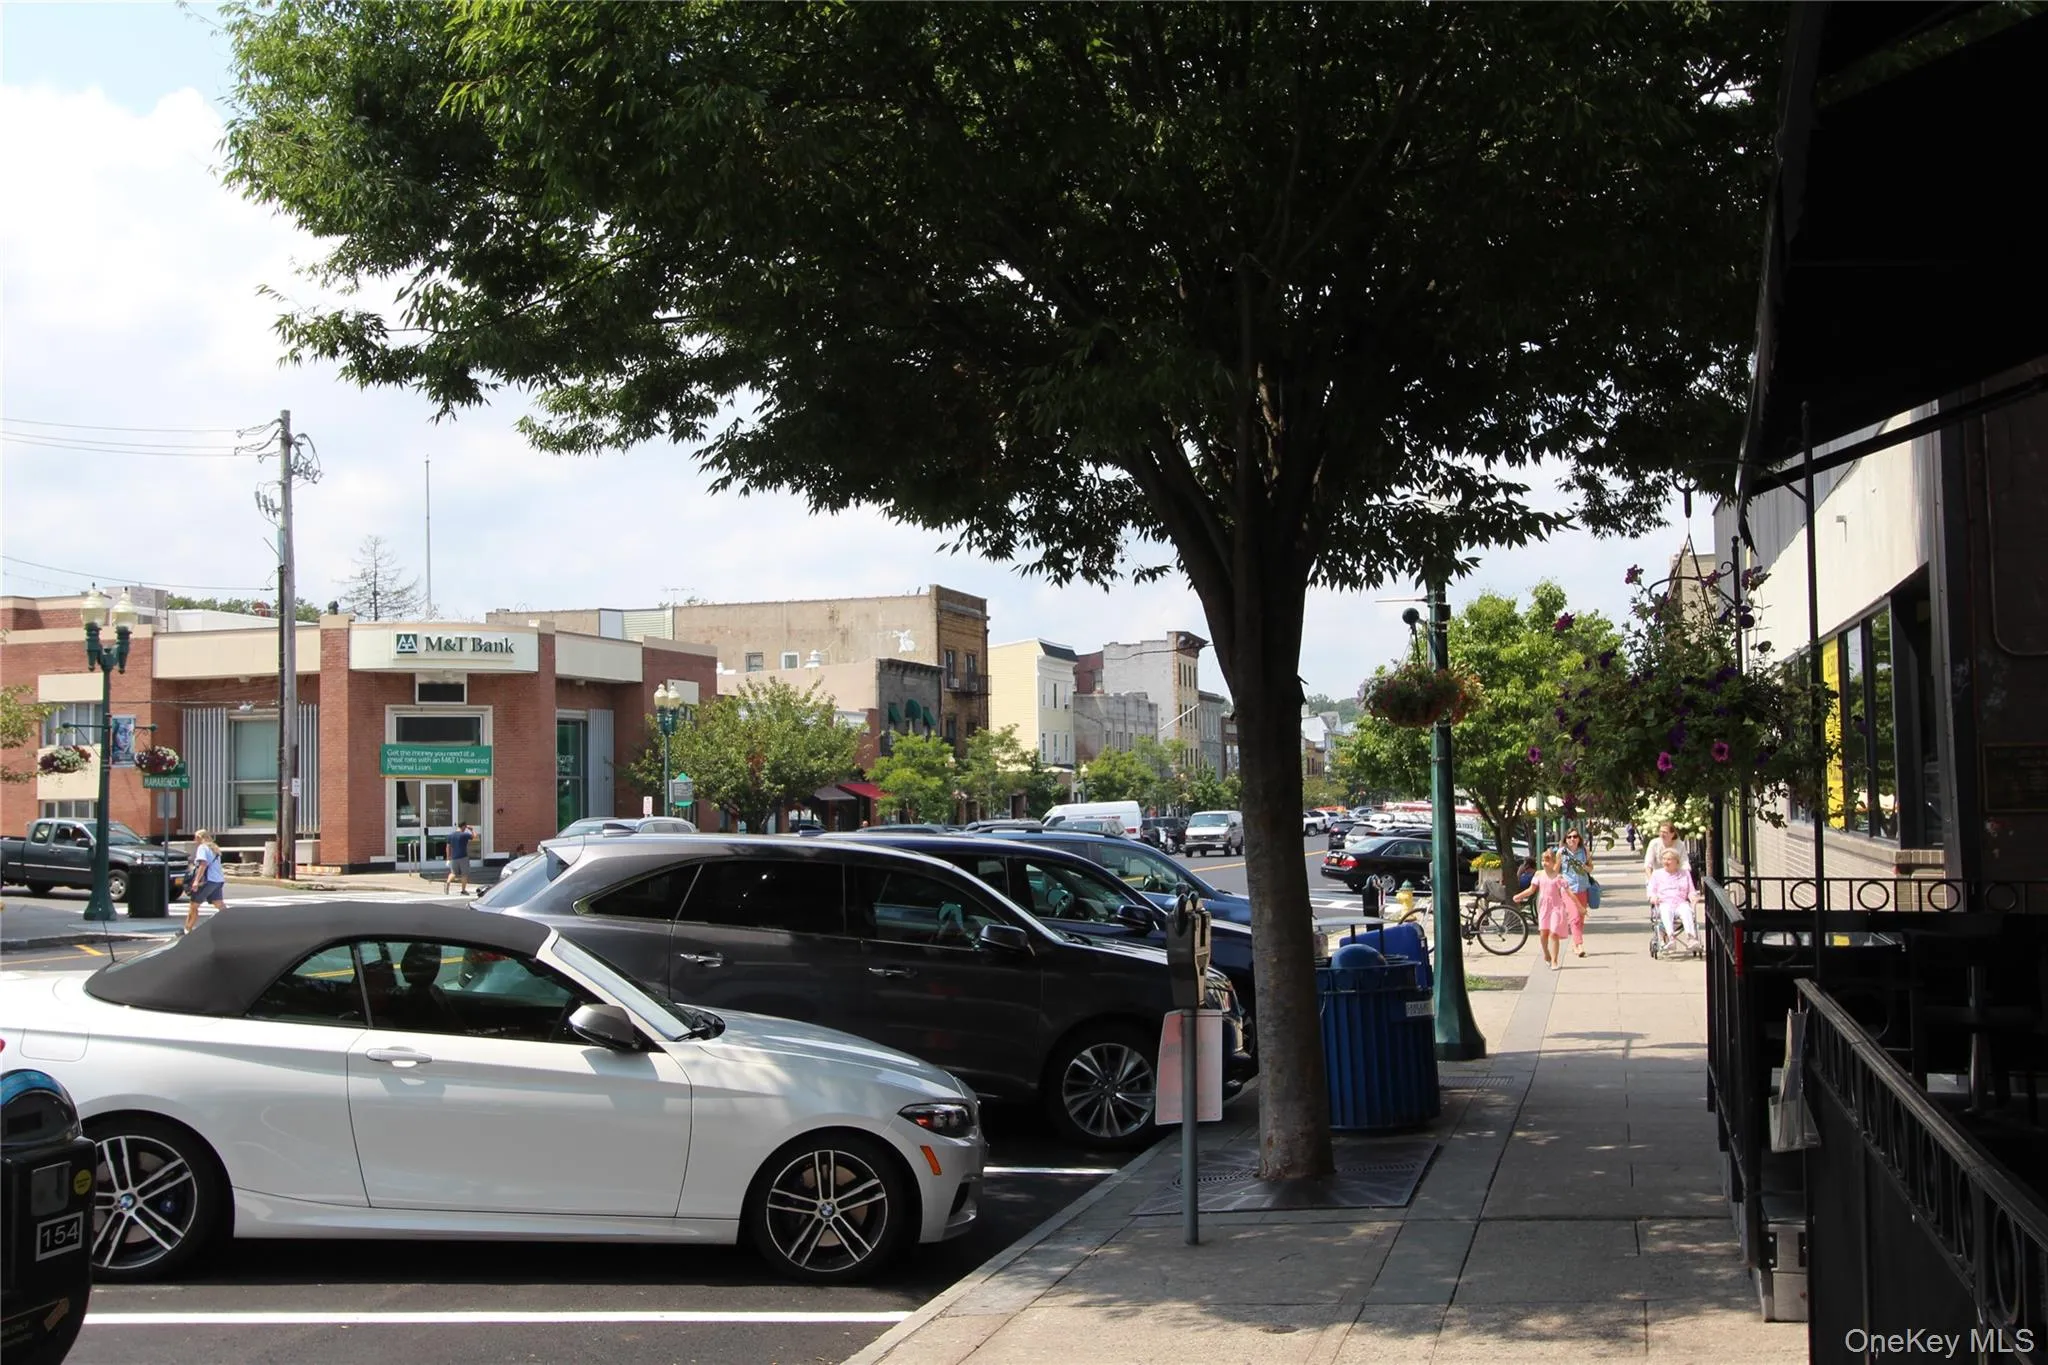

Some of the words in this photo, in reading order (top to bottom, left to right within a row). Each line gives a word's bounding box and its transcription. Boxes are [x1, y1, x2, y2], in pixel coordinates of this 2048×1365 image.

[424, 636, 467, 652] M&T
[470, 637, 515, 654] Bank
[42, 1221, 78, 1249] 154
